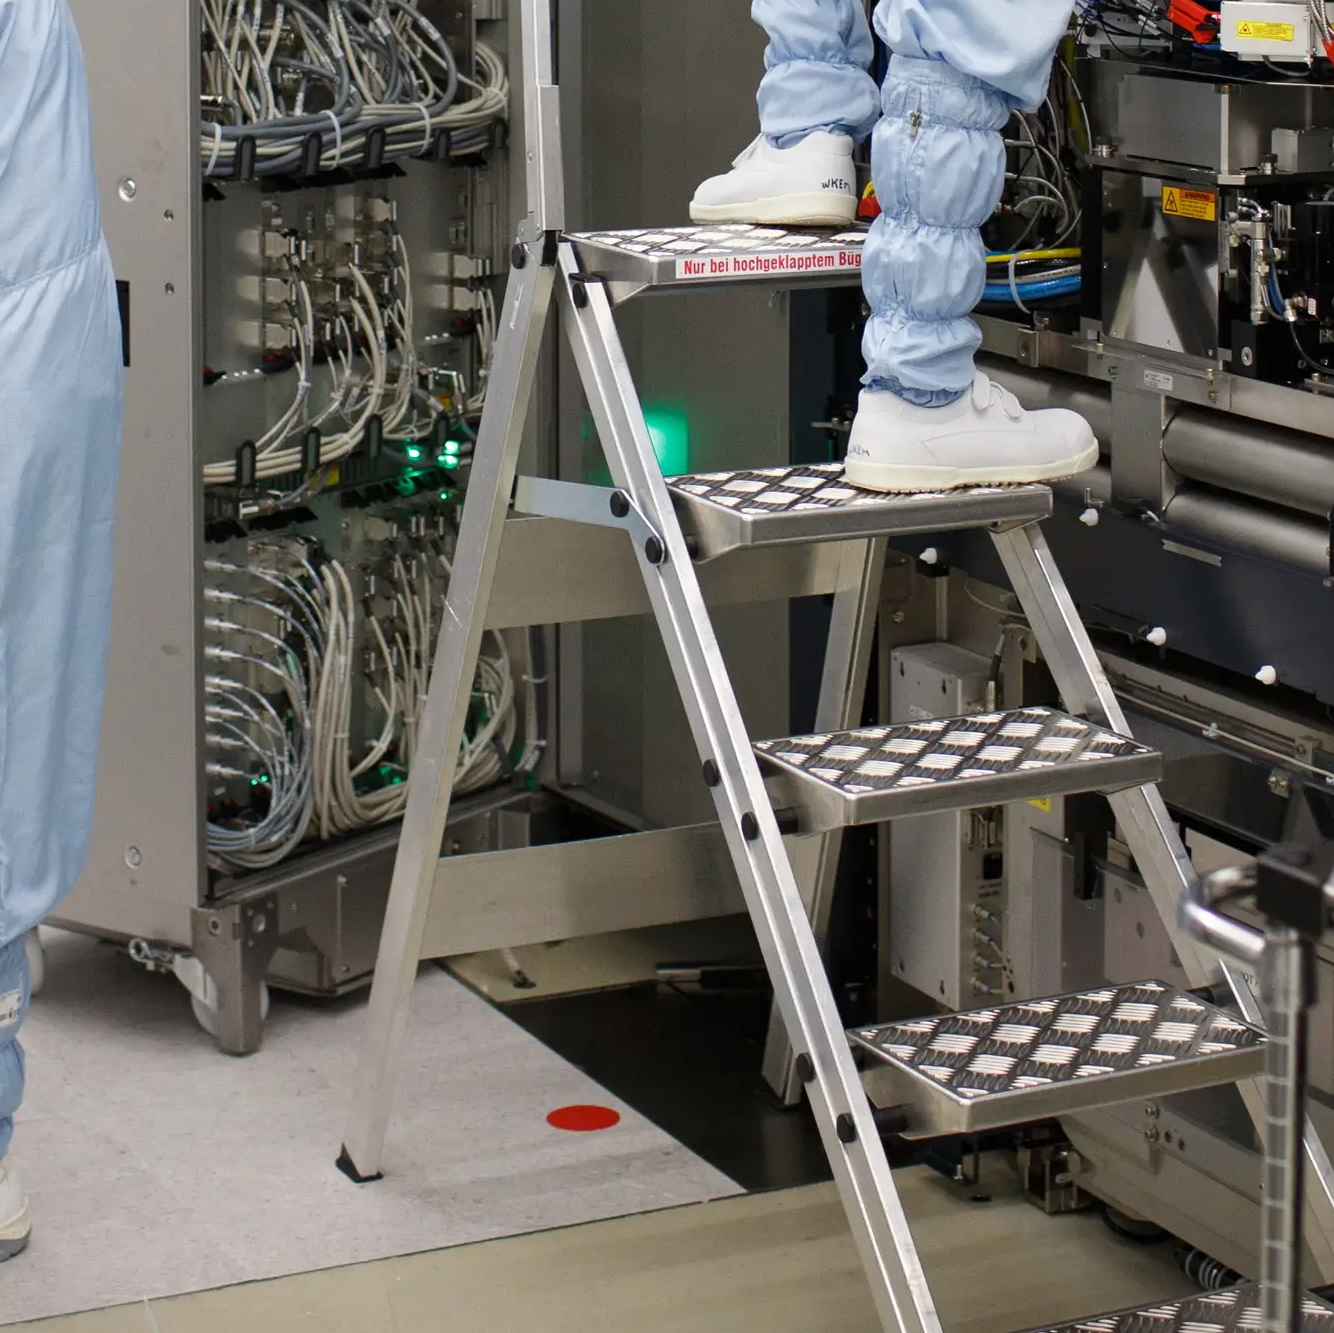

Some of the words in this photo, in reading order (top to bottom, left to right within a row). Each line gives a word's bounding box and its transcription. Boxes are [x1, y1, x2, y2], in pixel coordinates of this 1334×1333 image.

[684, 260, 705, 274] Nur
[710, 258, 729, 273] bei
[733, 253, 834, 272] hochgeklapptem
